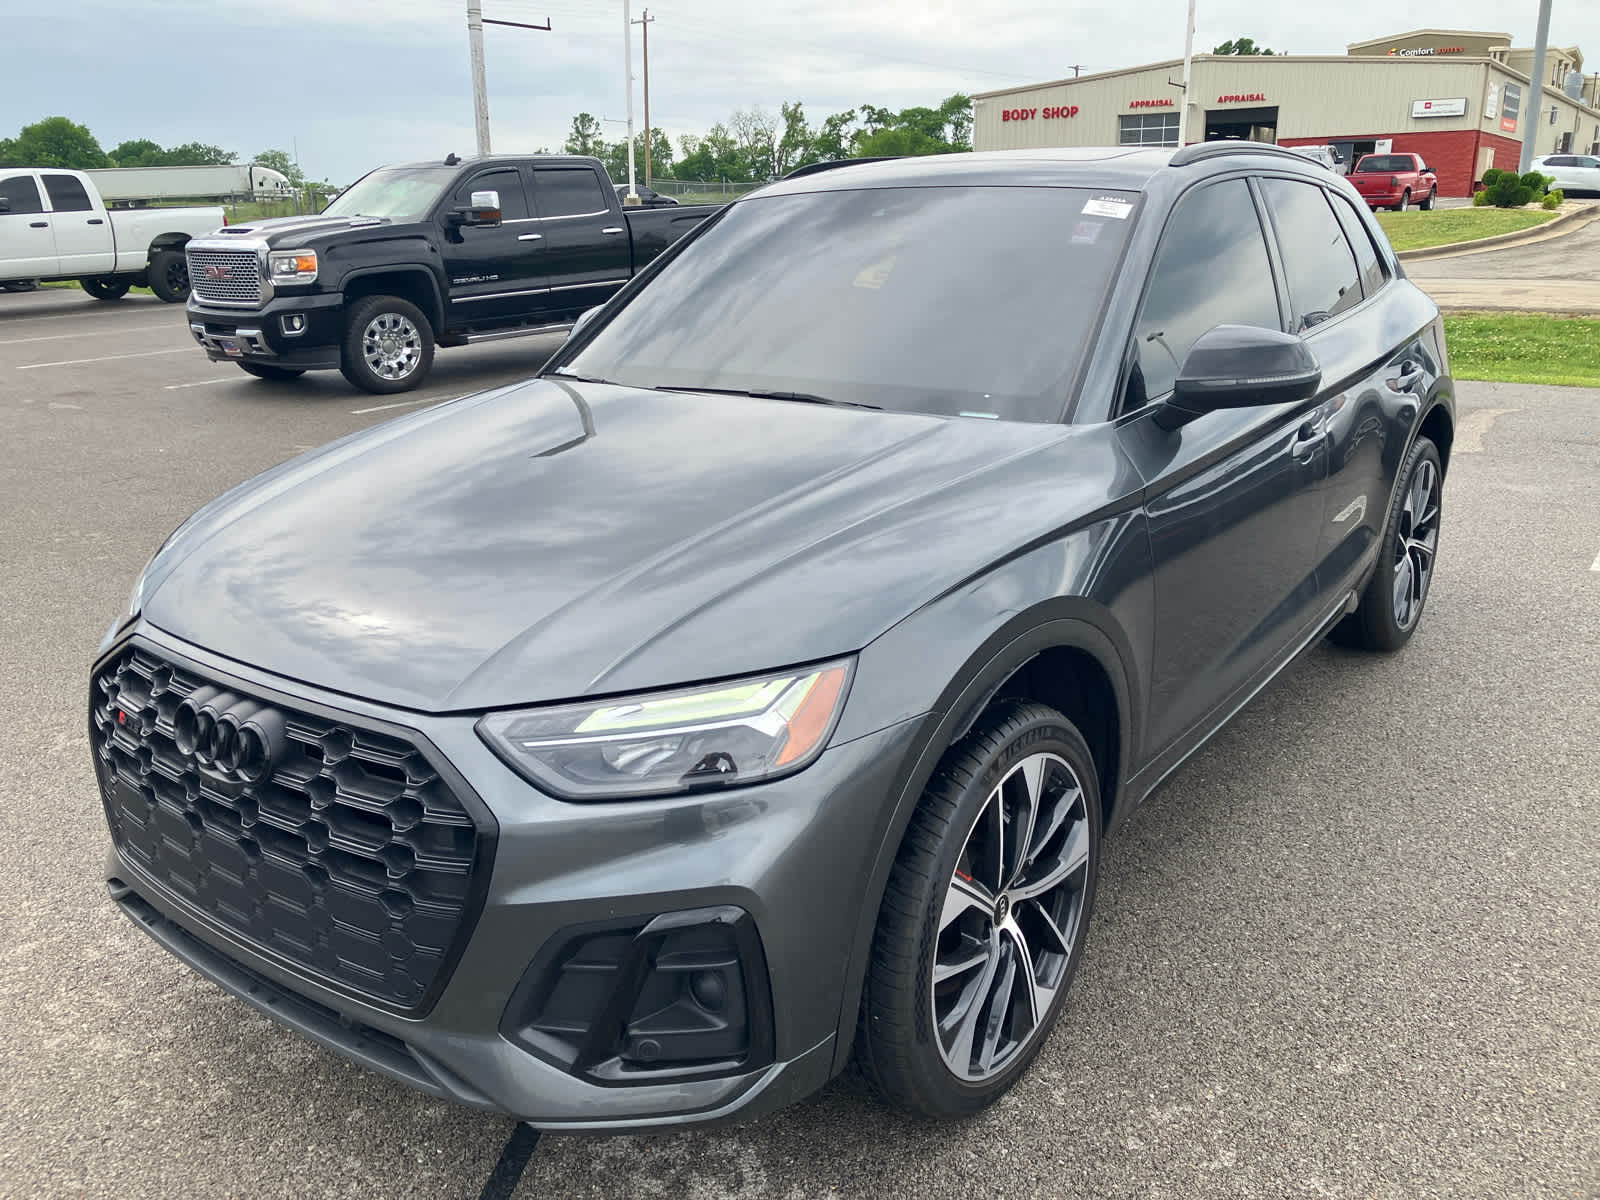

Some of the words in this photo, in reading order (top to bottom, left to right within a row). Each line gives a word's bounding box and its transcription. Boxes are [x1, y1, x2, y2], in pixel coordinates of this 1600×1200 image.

[1399, 47, 1434, 56] Comfort
[1129, 98, 1174, 109] APPRAISAL
[1217, 93, 1267, 103] APPRAISAL
[1001, 108, 1037, 122] BODY
[1042, 105, 1079, 120] SHOP
[204, 265, 232, 280] GMC
